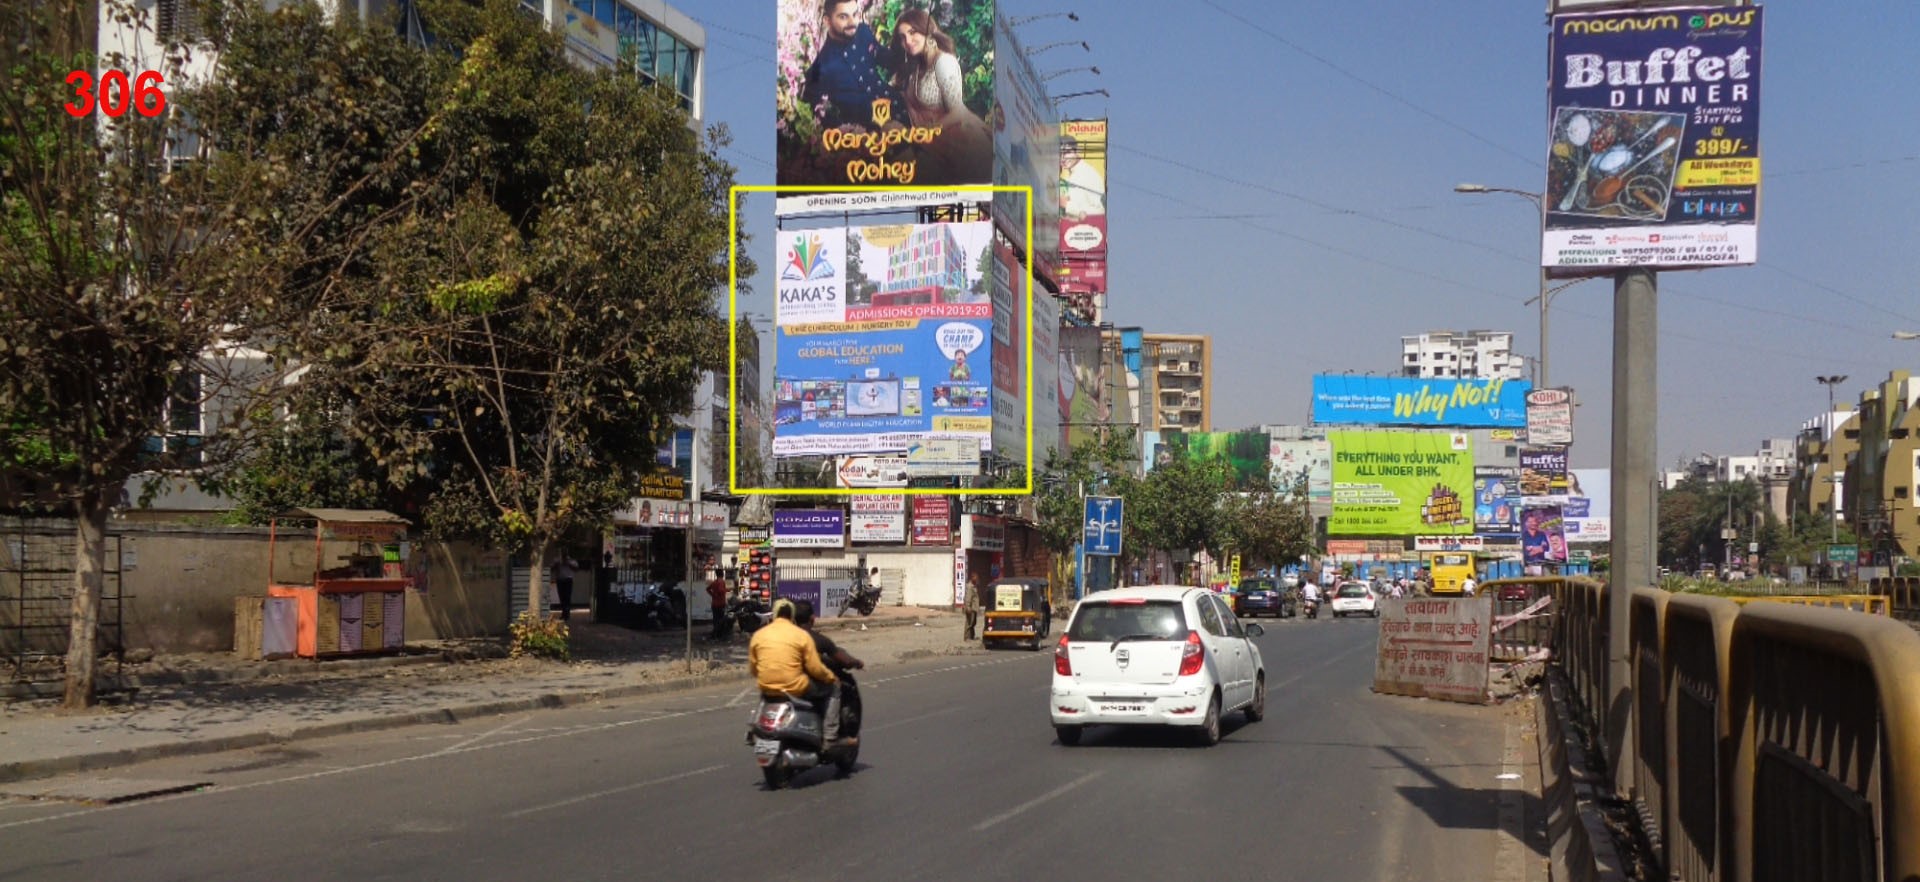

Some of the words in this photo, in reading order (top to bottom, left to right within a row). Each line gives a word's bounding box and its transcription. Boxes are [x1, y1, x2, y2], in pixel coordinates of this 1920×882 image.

[1563, 15, 1679, 35] magnum
[1565, 46, 1751, 88] Buffet
[1610, 84, 1749, 107] DINNER
[822, 124, 942, 155] Manyavar
[1695, 138, 1749, 156] 399/-
[846, 157, 916, 183] Mohey
[1703, 160, 1753, 169] Weekdays
[807, 197, 847, 207] OPENING
[851, 195, 877, 205] SOON
[881, 193, 928, 202] Chinchwad
[780, 285, 836, 302] KAKA'S
[849, 306, 913, 320] ADMISSIONS
[915, 305, 946, 316] OPEN
[946, 304, 989, 316] 2019-20
[943, 334, 974, 344] CHAMP
[798, 347, 839, 358] GLOBAL
[842, 344, 904, 356] EDUCATION
[1394, 384, 1449, 422] Why
[1449, 378, 1505, 408] Not!
[1336, 452, 1401, 464] EVERYTHING
[1403, 452, 1423, 464] YOU
[1425, 452, 1461, 466] WANT,
[1522, 454, 1566, 465] Buffet
[839, 465, 866, 474] Kodak
[1355, 466, 1375, 476] ALL
[1378, 466, 1414, 476] UNDER
[1416, 467, 1441, 477] BHK.
[855, 502, 879, 510] IMPLANT
[1405, 601, 1450, 615] सावधान
